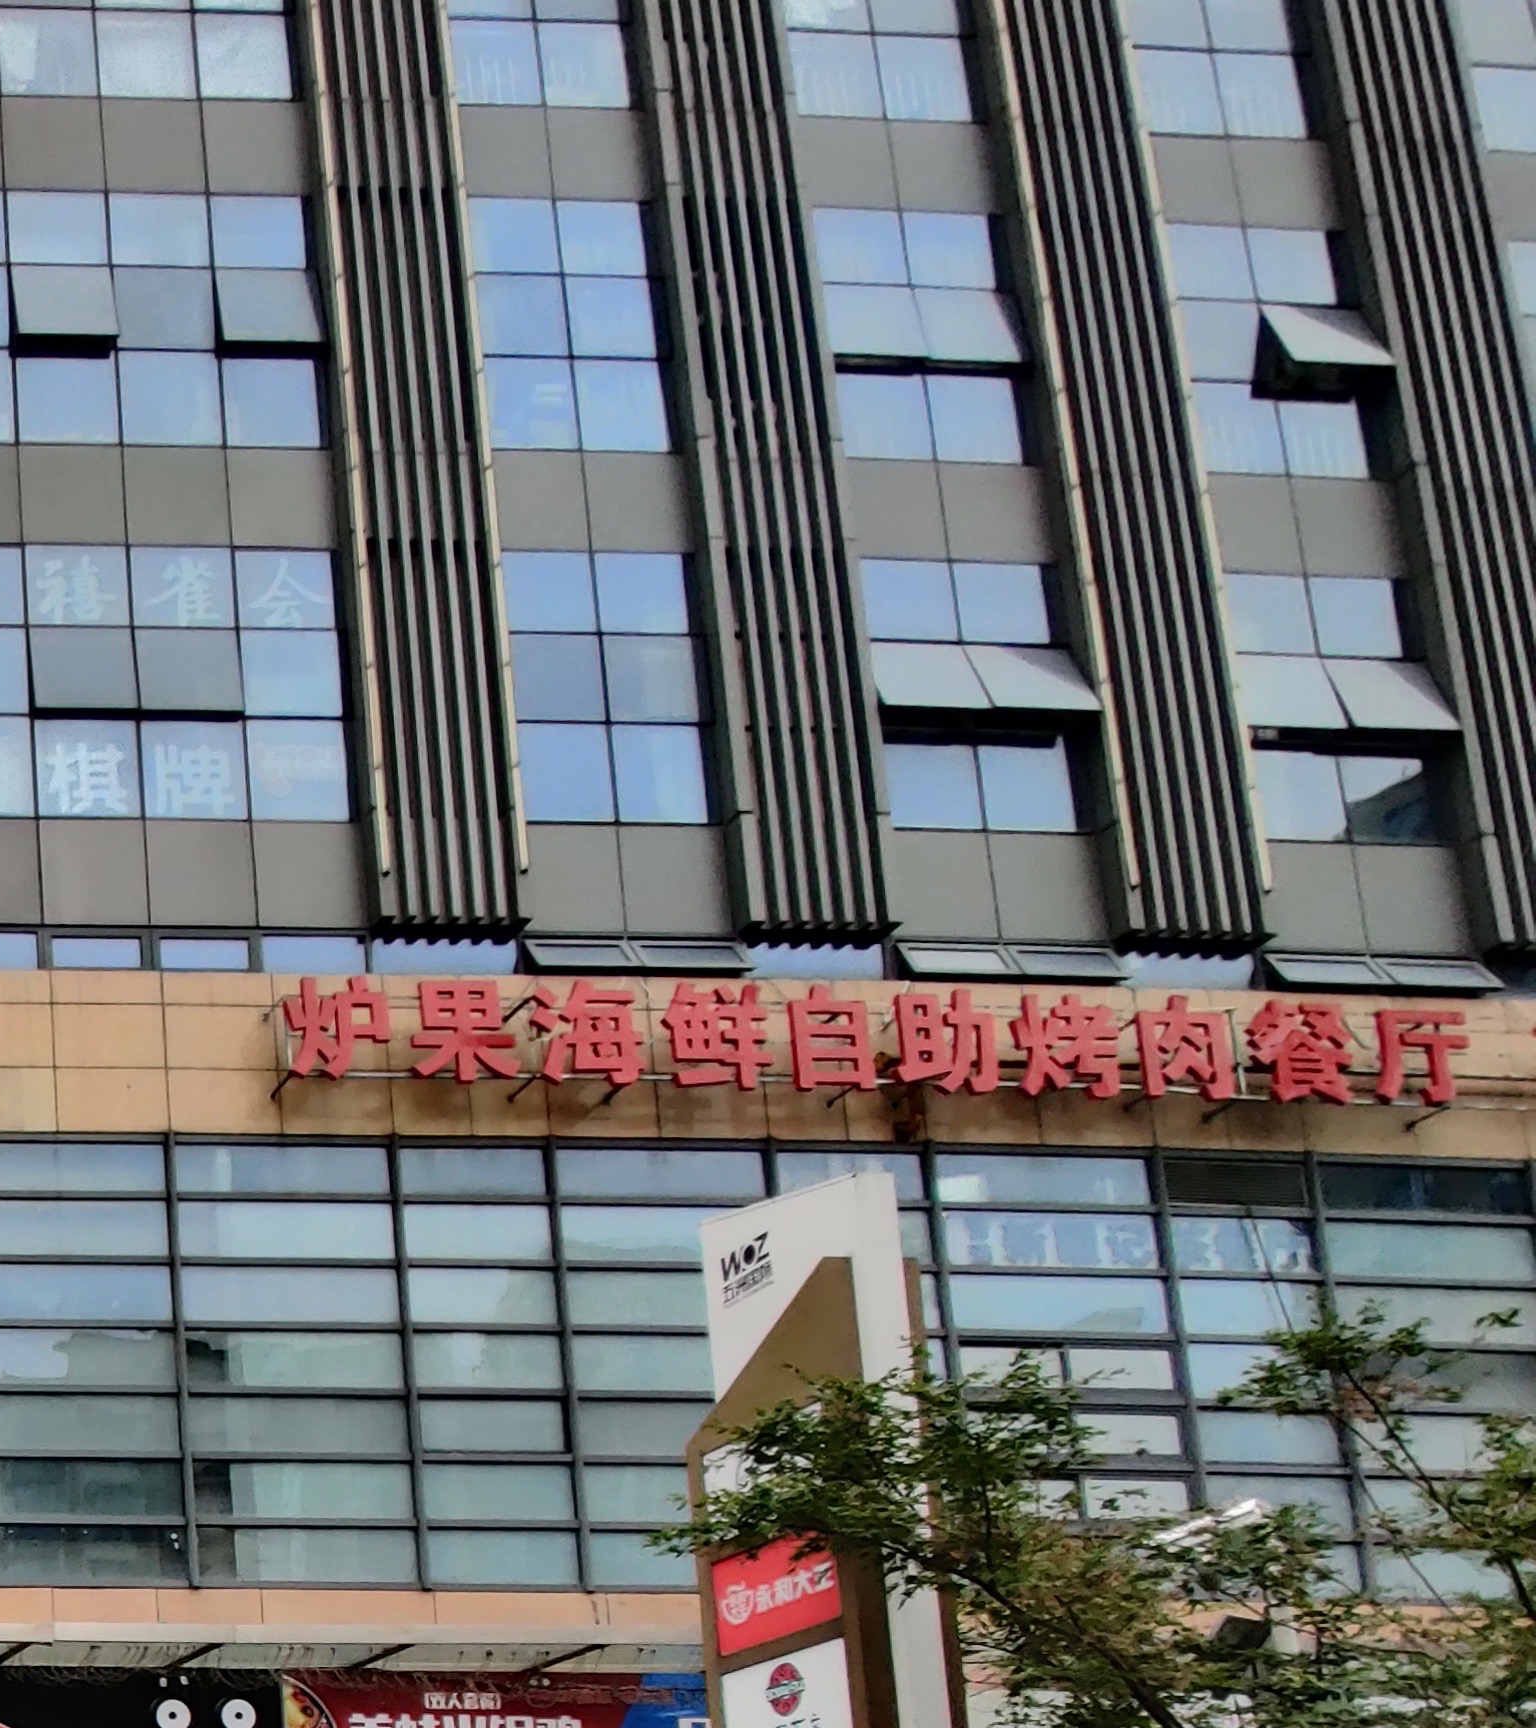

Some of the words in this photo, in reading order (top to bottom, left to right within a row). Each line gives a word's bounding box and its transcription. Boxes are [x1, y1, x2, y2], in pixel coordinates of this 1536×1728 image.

[46, 742, 236, 815] 棋牌
[282, 975, 1470, 1106] 炉果海鲜自助烤肉餐厅
[755, 1560, 835, 1615] 永和大王
